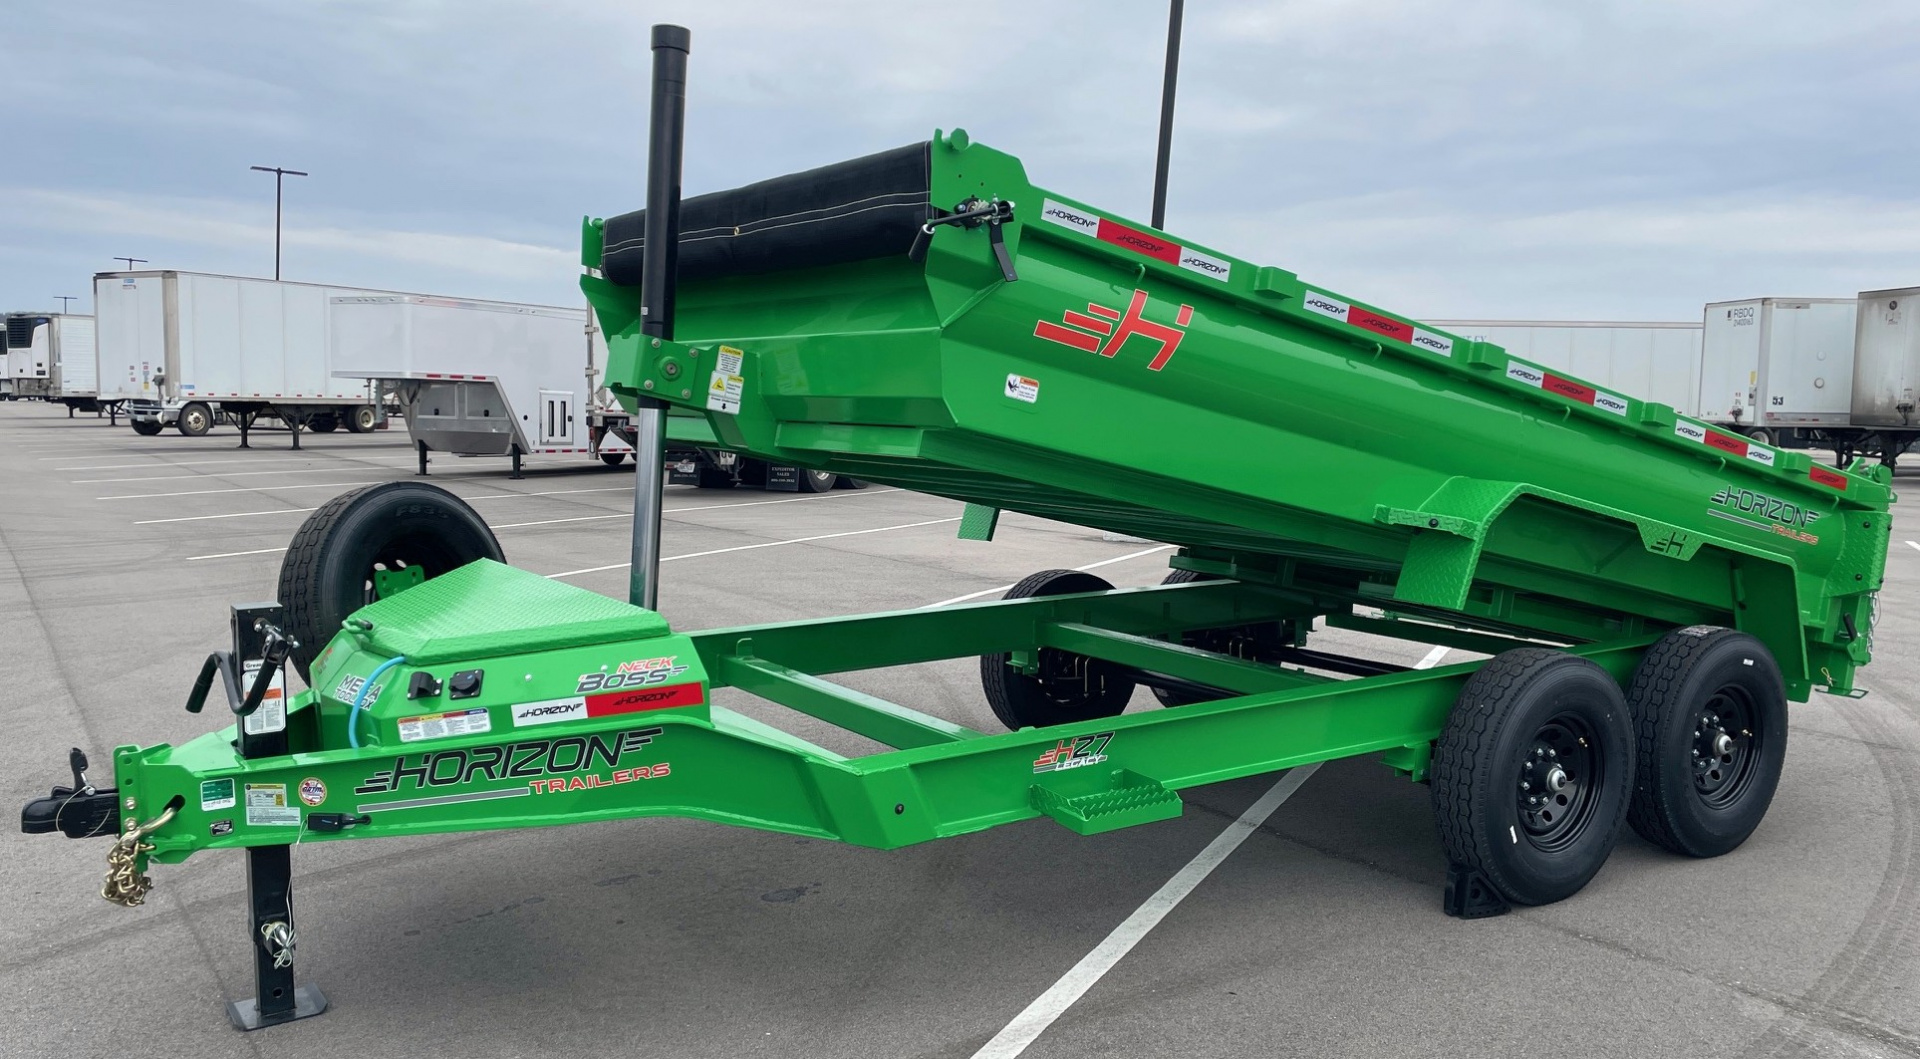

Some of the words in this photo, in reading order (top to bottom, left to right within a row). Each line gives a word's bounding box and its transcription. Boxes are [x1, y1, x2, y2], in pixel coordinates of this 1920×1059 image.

[1050, 208, 1093, 228] HORIZON
[1121, 234, 1161, 253] HORIZON
[1188, 256, 1224, 275] HORIZON
[1311, 299, 1343, 315] HORIZON
[1366, 316, 1397, 333] HORIZON
[1417, 336, 1448, 350] HORIZON
[1772, 396, 1784, 406] 53
[1723, 485, 1809, 529] HORIZON
[1771, 523, 1820, 546] TRAILERS
[616, 656, 677, 675] NECK
[338, 674, 383, 700] MEA
[575, 666, 674, 694] BOSS
[333, 688, 374, 711] TOOLOX
[618, 692, 674, 705] HORIZON
[525, 703, 577, 718] HORIZON
[390, 731, 625, 791] HORIZON
[1054, 754, 1102, 772] LEGACY
[529, 763, 671, 795] TRAILERS
